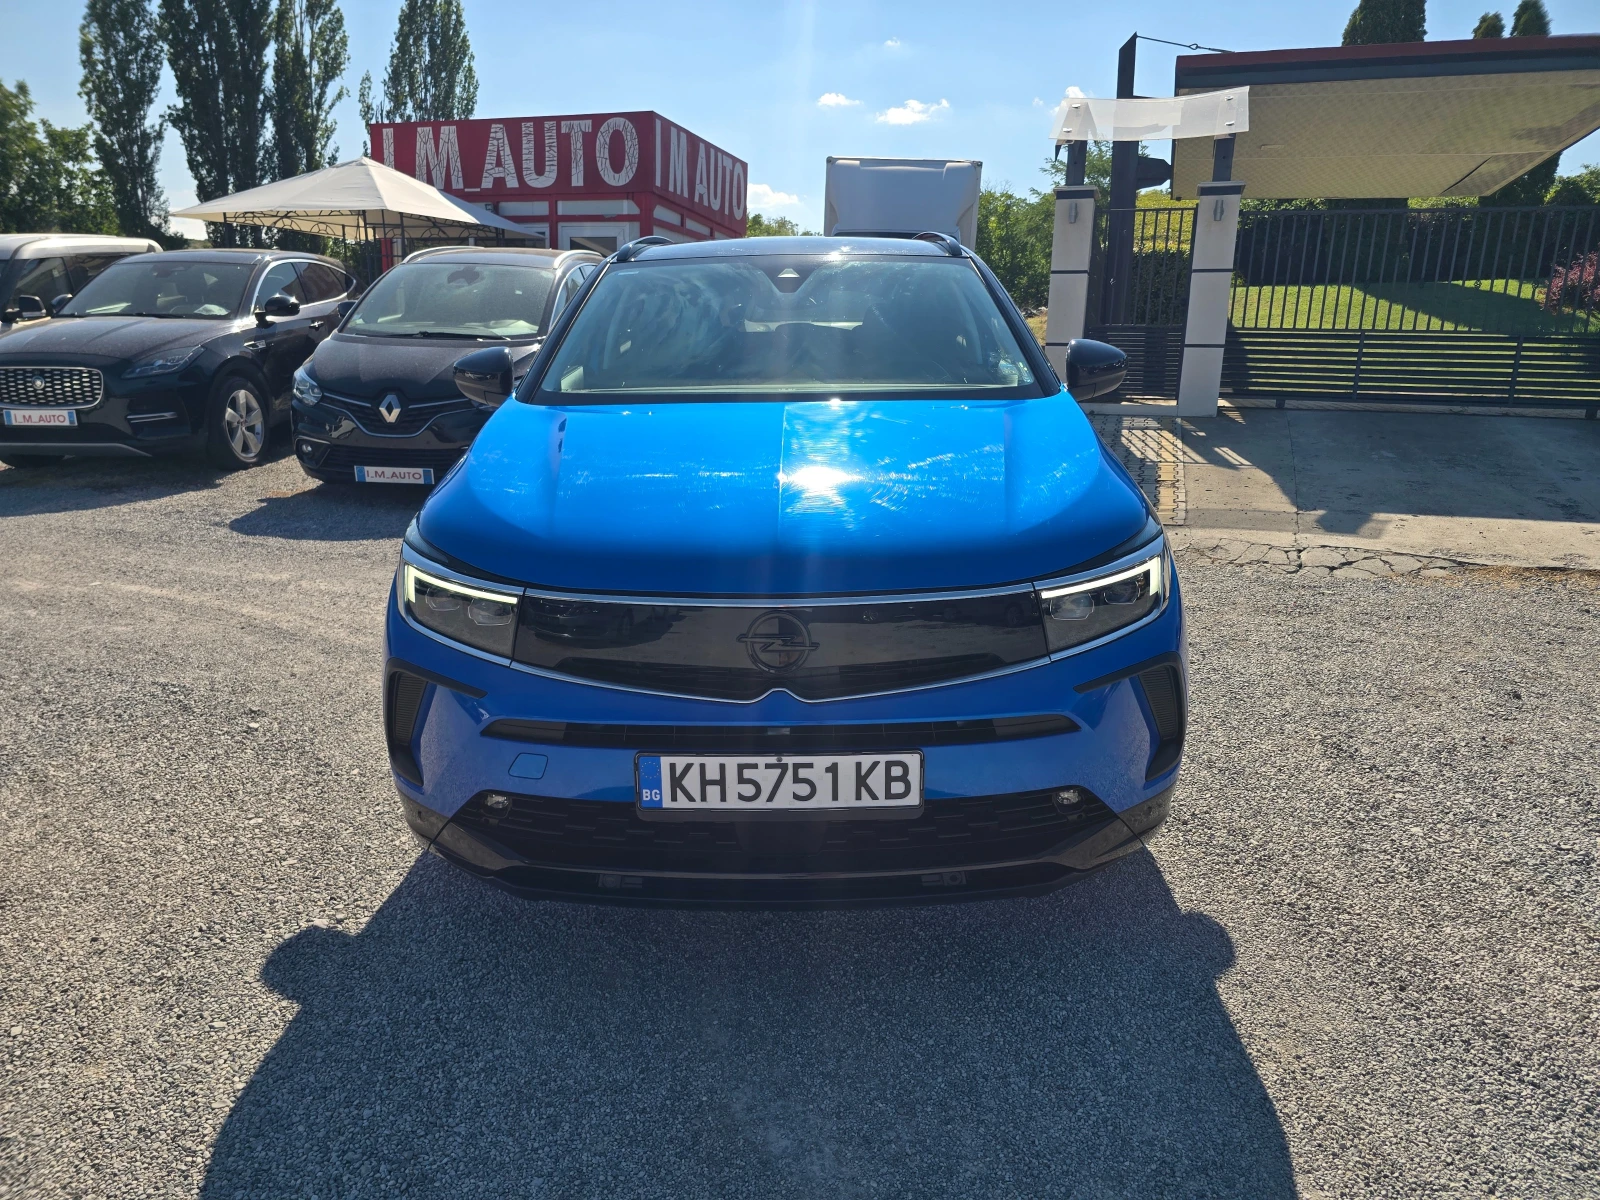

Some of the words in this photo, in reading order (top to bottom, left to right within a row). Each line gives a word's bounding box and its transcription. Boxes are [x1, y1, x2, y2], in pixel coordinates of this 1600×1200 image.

[668, 125, 689, 199] M
[694, 142, 745, 221] AUTO
[642, 788, 661, 801] BG
